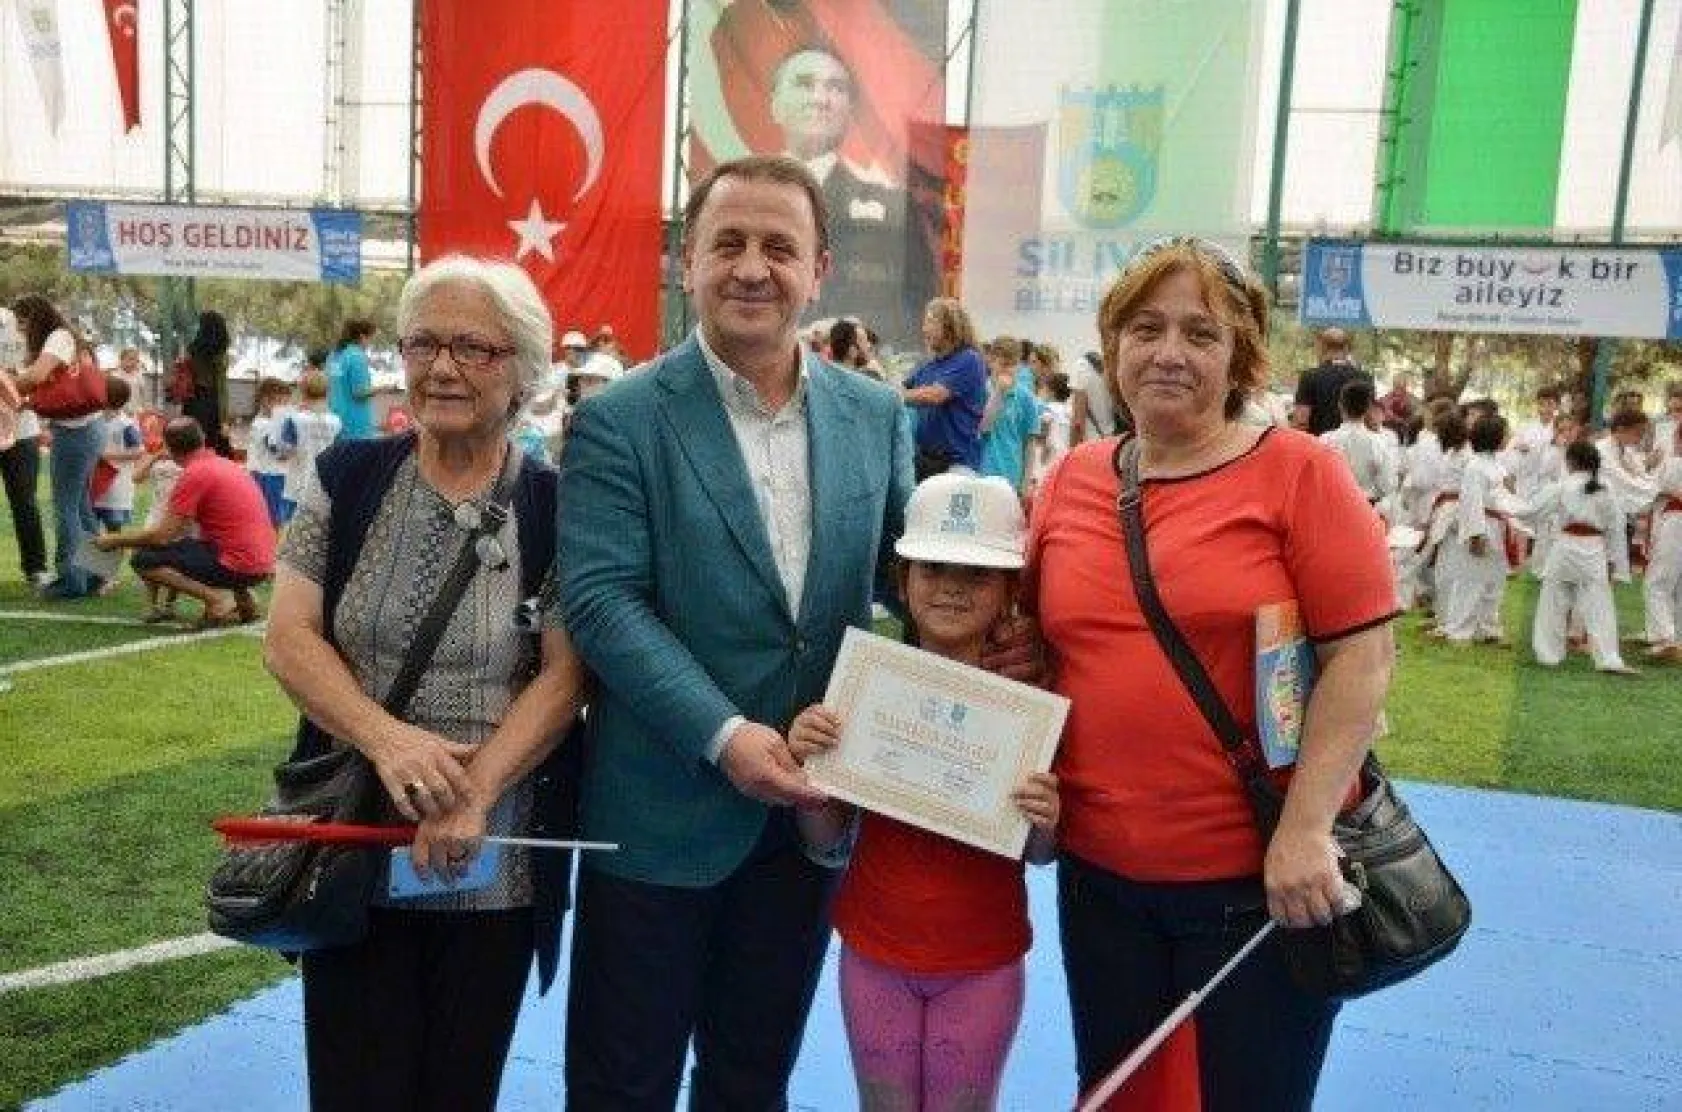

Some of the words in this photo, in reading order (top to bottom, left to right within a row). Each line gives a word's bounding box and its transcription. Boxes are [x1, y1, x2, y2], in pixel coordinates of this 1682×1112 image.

[183, 218, 309, 251] GELDİNİZ
[1592, 257, 1638, 281] bir
[1456, 281, 1563, 308] aileyiz
